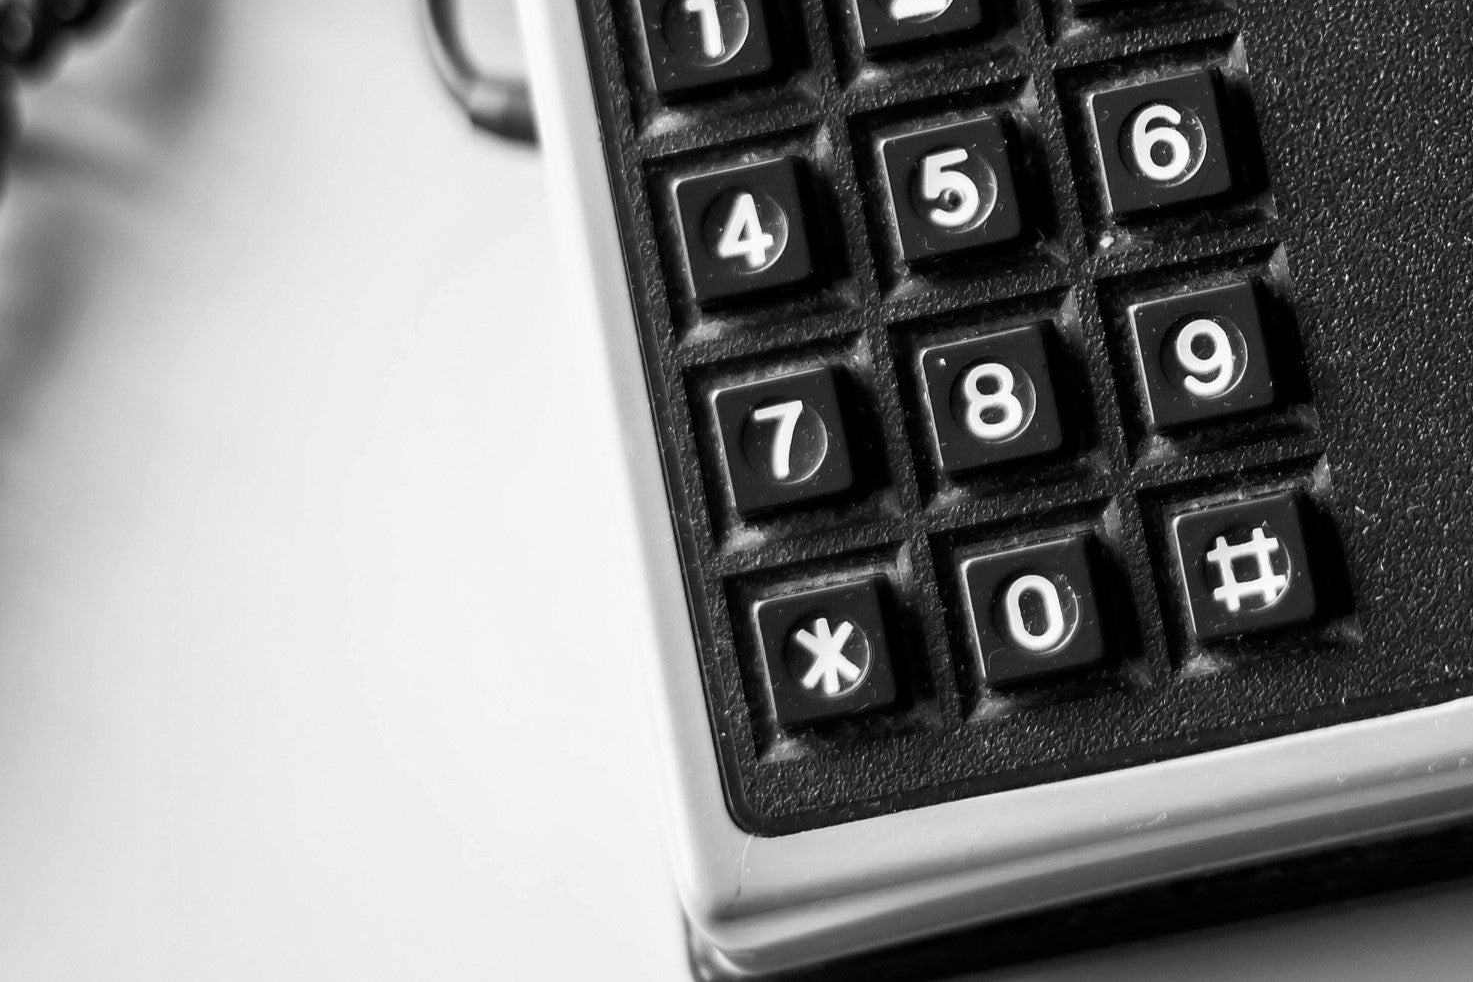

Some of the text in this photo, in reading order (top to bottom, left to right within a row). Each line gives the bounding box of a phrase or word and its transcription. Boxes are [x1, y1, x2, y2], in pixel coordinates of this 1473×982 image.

[1132, 104, 1192, 181] 6
[923, 148, 981, 227] 5
[718, 193, 775, 268] 4
[1175, 319, 1236, 397] 9
[963, 362, 1024, 439] 8
[753, 400, 804, 480] 7
[1206, 527, 1289, 612] #
[1005, 574, 1065, 651] 0
